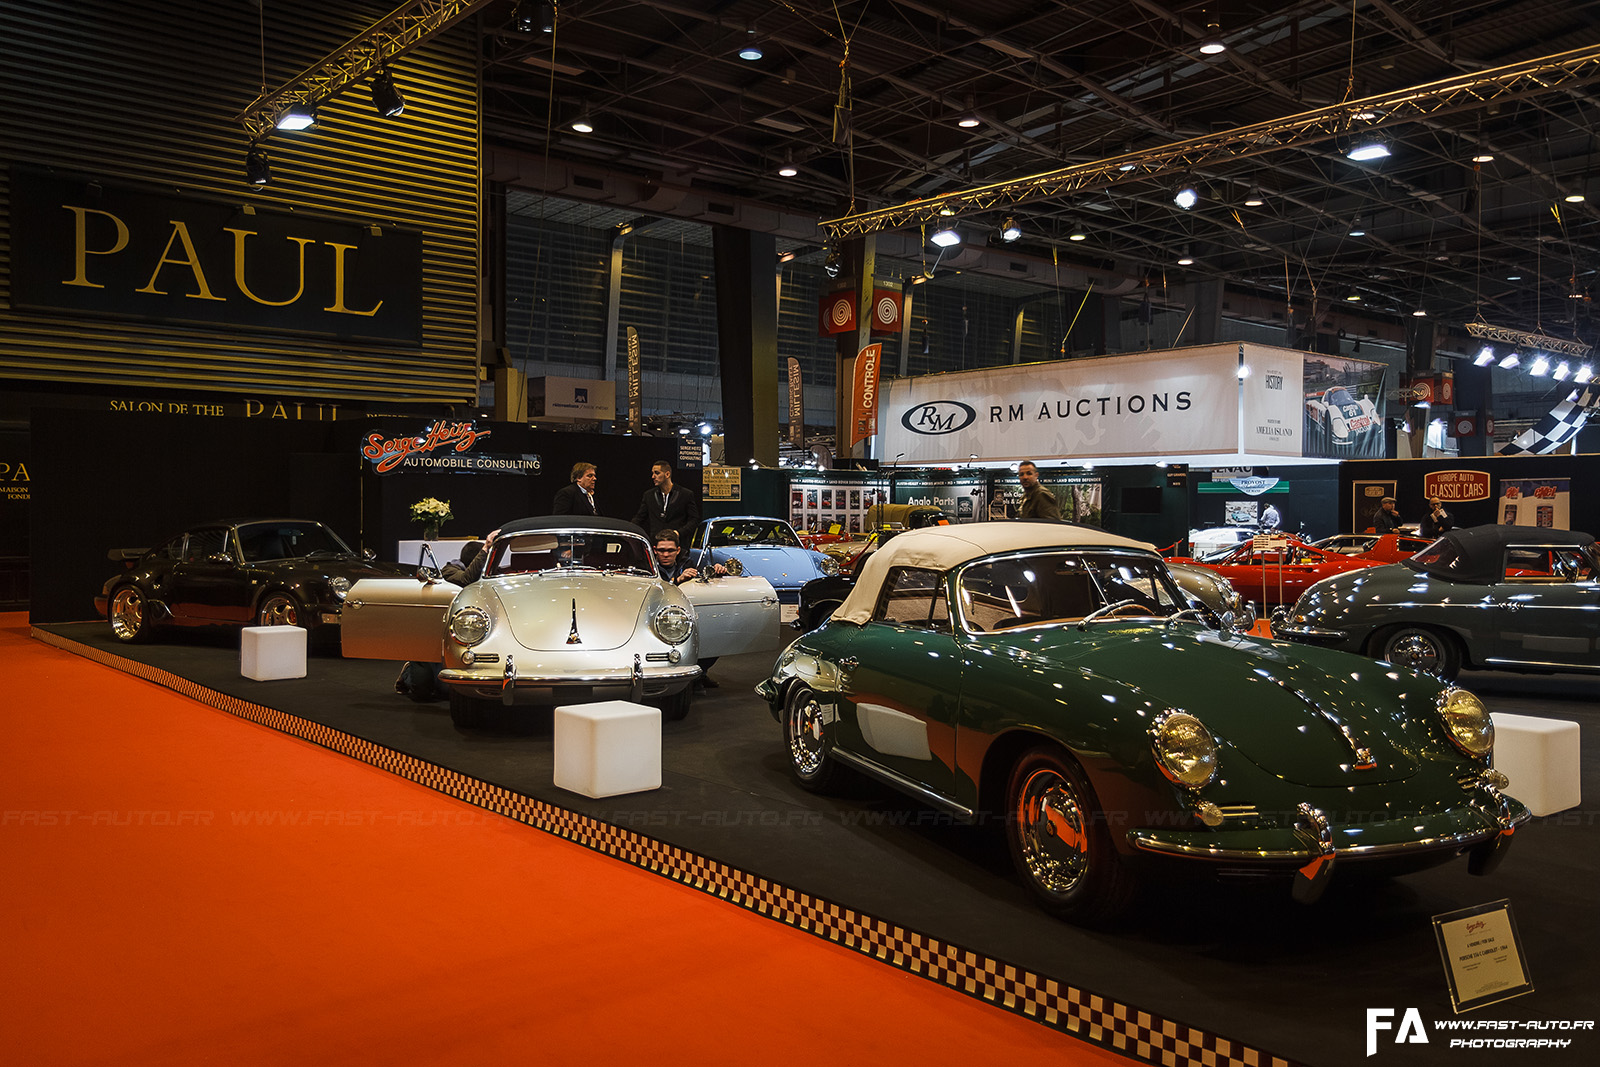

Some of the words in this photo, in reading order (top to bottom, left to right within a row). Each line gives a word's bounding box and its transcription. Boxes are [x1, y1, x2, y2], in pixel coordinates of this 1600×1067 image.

[62, 204, 384, 317] PAUL
[862, 349, 876, 409] CONTROLE
[109, 400, 163, 413] SALON
[168, 403, 189, 415] DE
[192, 404, 224, 417] THE
[989, 403, 1025, 423] RM
[1037, 391, 1192, 420] AUCTIONS
[916, 405, 957, 432] RM
[363, 432, 424, 473] Serge
[420, 419, 492, 453] Heitz
[403, 457, 473, 468] AUTOMOBILE
[476, 459, 541, 469] CONSULTING
[1437, 473, 1458, 482] EUROPE
[1459, 473, 1475, 482] AUTO
[907, 495, 932, 506] Anglo
[933, 495, 955, 506] Parts
[1430, 483, 1461, 498] CLASSIC
[1463, 483, 1484, 498] CARS
